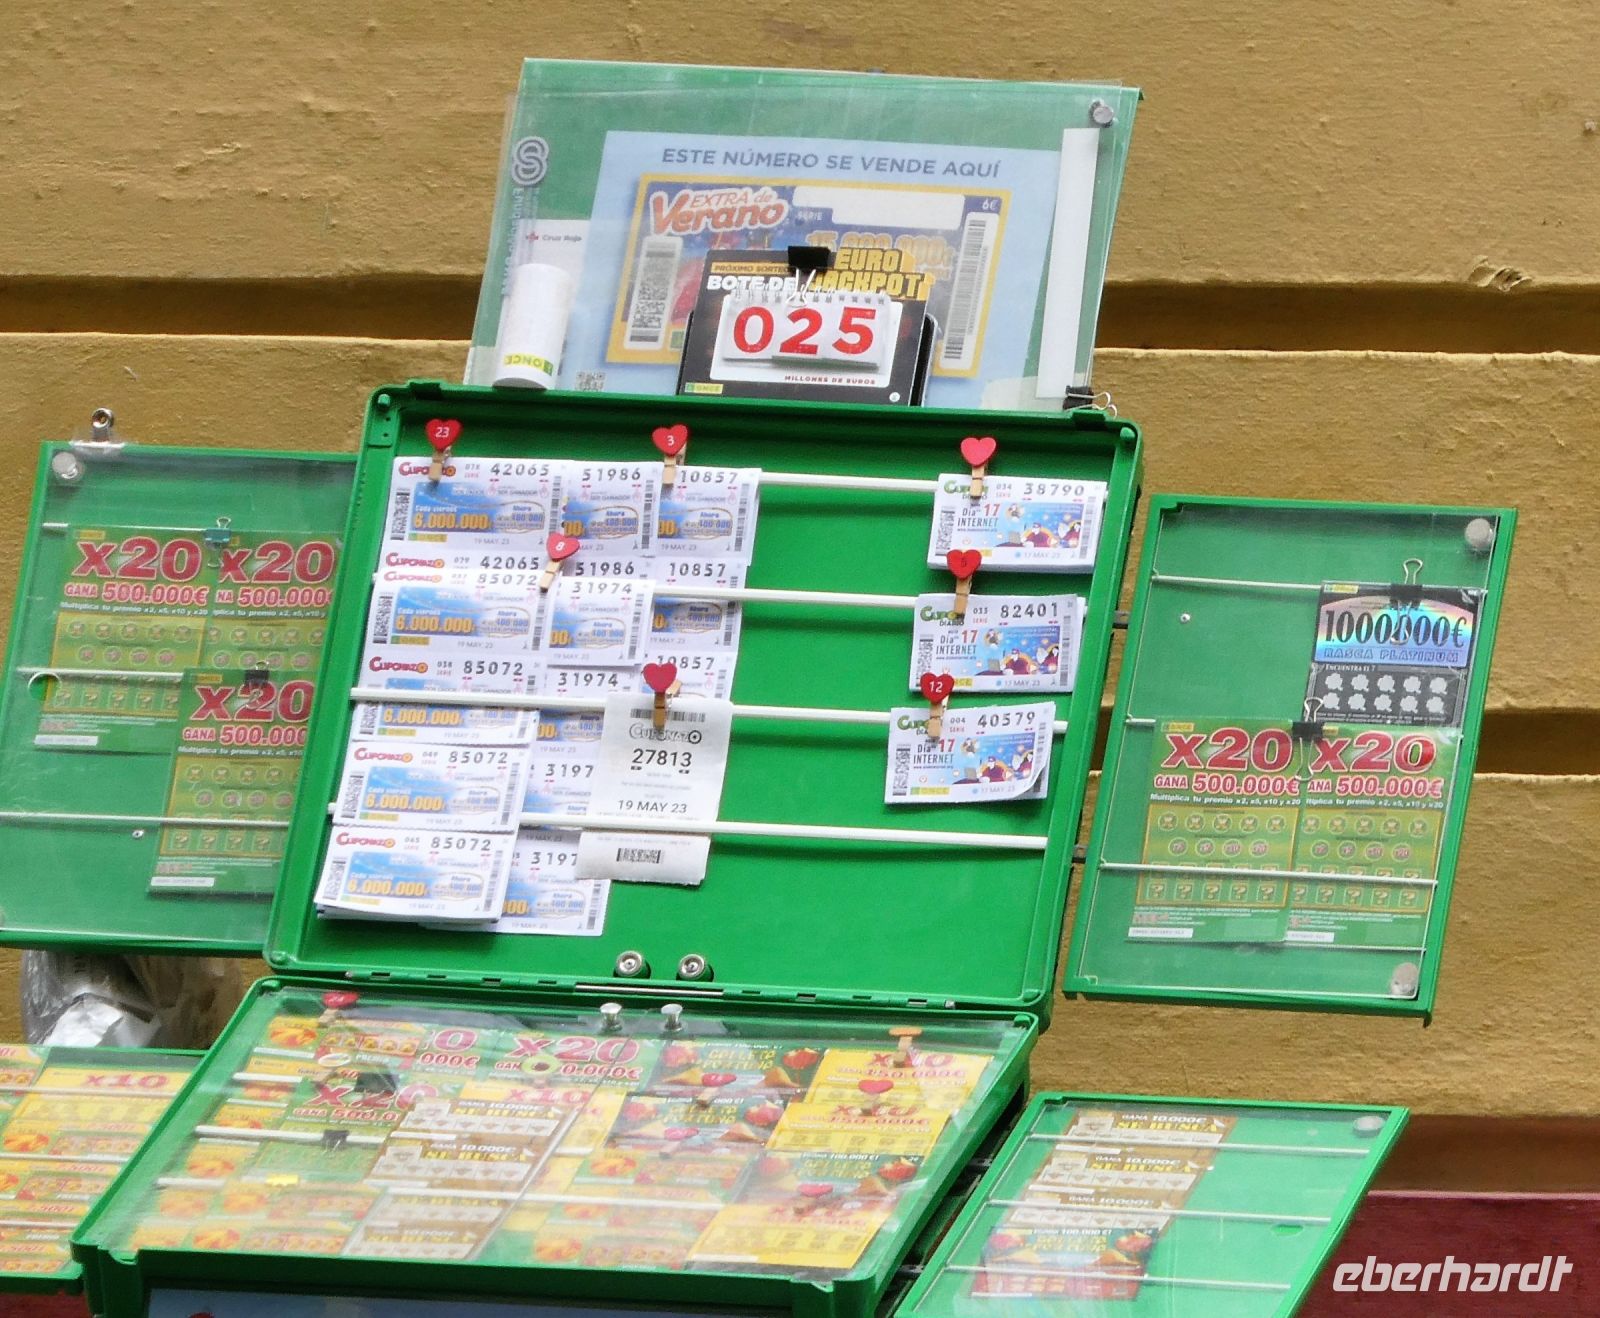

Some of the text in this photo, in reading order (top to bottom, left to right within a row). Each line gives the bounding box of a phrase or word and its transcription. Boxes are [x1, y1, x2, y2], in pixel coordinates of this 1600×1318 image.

[662, 148, 1002, 178] ESTE NÚMERO SE VENDE AQUÍ
[691, 189, 748, 205] EXTRA
[652, 193, 785, 233] Verano
[834, 249, 902, 272] EURO
[714, 264, 754, 273] PRÓXIMO
[707, 275, 796, 292] BOTE DE
[503, 353, 541, 370] ONCE
[784, 375, 828, 383] MILLONES
[435, 427, 449, 438] 23
[667, 435, 674, 446] 3
[490, 463, 549, 476] 42065
[582, 468, 641, 481] 51986
[680, 471, 738, 483] 10857
[1023, 483, 1085, 496] 38790
[984, 504, 1001, 516] 17
[957, 518, 999, 527] INTERNET
[556, 541, 565, 550] 8
[72, 536, 202, 582] x20
[219, 540, 335, 584] x20
[386, 552, 539, 570] CUPONAZO 42065
[575, 561, 635, 577] 51986
[669, 562, 726, 578] 10857
[477, 574, 537, 586] 85072
[64, 582, 209, 606] GANA 500.000€
[572, 581, 633, 594] 31974
[1000, 602, 1058, 618] 82401
[1325, 610, 1467, 648] 1.000000€
[961, 630, 978, 643] 17
[936, 645, 976, 655] INTERNET
[1324, 647, 1458, 663] RASCA PLATINUM
[369, 656, 429, 674] CUPONAZO
[464, 661, 523, 676] 85072
[558, 672, 619, 687] 31974
[929, 680, 942, 693] 12
[190, 680, 316, 722] x20
[977, 711, 1036, 728] 40579
[183, 727, 216, 741] GANA
[939, 739, 955, 752] 17
[1162, 727, 1294, 771] x20
[1310, 732, 1437, 773] x20
[354, 747, 508, 764] CUPONAZO 85072
[632, 748, 692, 767] 27813
[913, 754, 954, 764] INTERNET
[545, 763, 594, 779] 3197
[1154, 773, 1299, 796] GANA 500.000€
[1308, 775, 1444, 798] ANA 500.000€
[1150, 794, 1190, 802] Multiplica
[618, 800, 687, 813] 19 MAY 23
[336, 832, 491, 851] CUPONAZO 85072
[531, 852, 577, 866] 3197
[506, 1036, 640, 1064] x20
[495, 1062, 522, 1070] GAN
[85, 1074, 169, 1088] x10
[490, 1102, 544, 1111] 10.000€
[1122, 1114, 1207, 1124] GANA 10.000€
[1115, 1121, 1218, 1132] SE BUSCA
[461, 1144, 517, 1153] 10.000€
[1090, 1162, 1192, 1172] SE BUSCA
[1126, 1158, 1180, 1166] 10.000€
[1100, 1198, 1152, 1206] 10.000€
